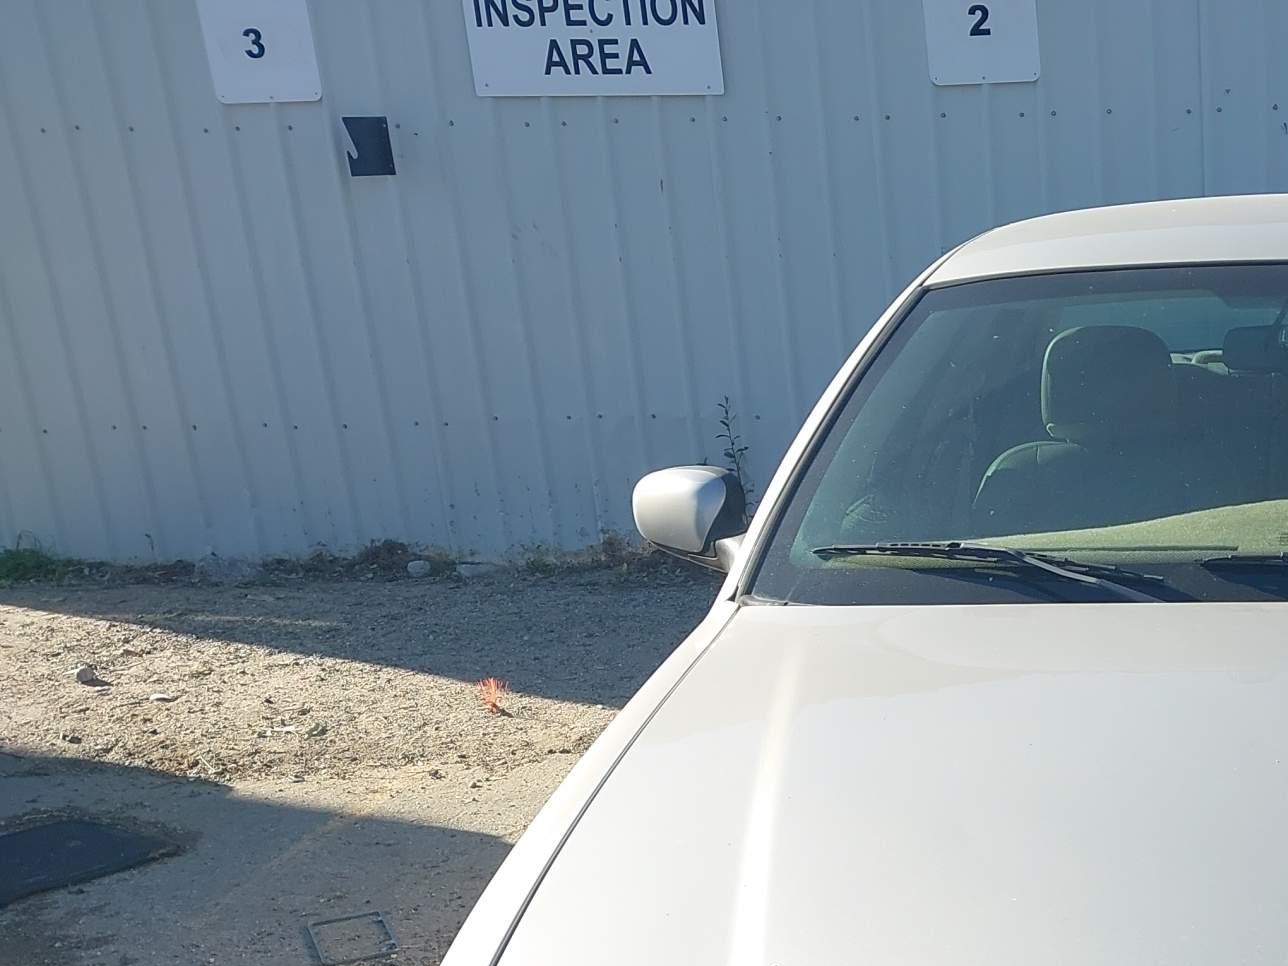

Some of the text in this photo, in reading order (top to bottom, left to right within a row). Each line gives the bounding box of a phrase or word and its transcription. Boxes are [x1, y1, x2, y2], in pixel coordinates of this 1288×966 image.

[473, 0, 706, 27] INSPECTION
[967, 4, 992, 37] 2
[242, 27, 266, 59] 3
[544, 38, 652, 75] AREA
